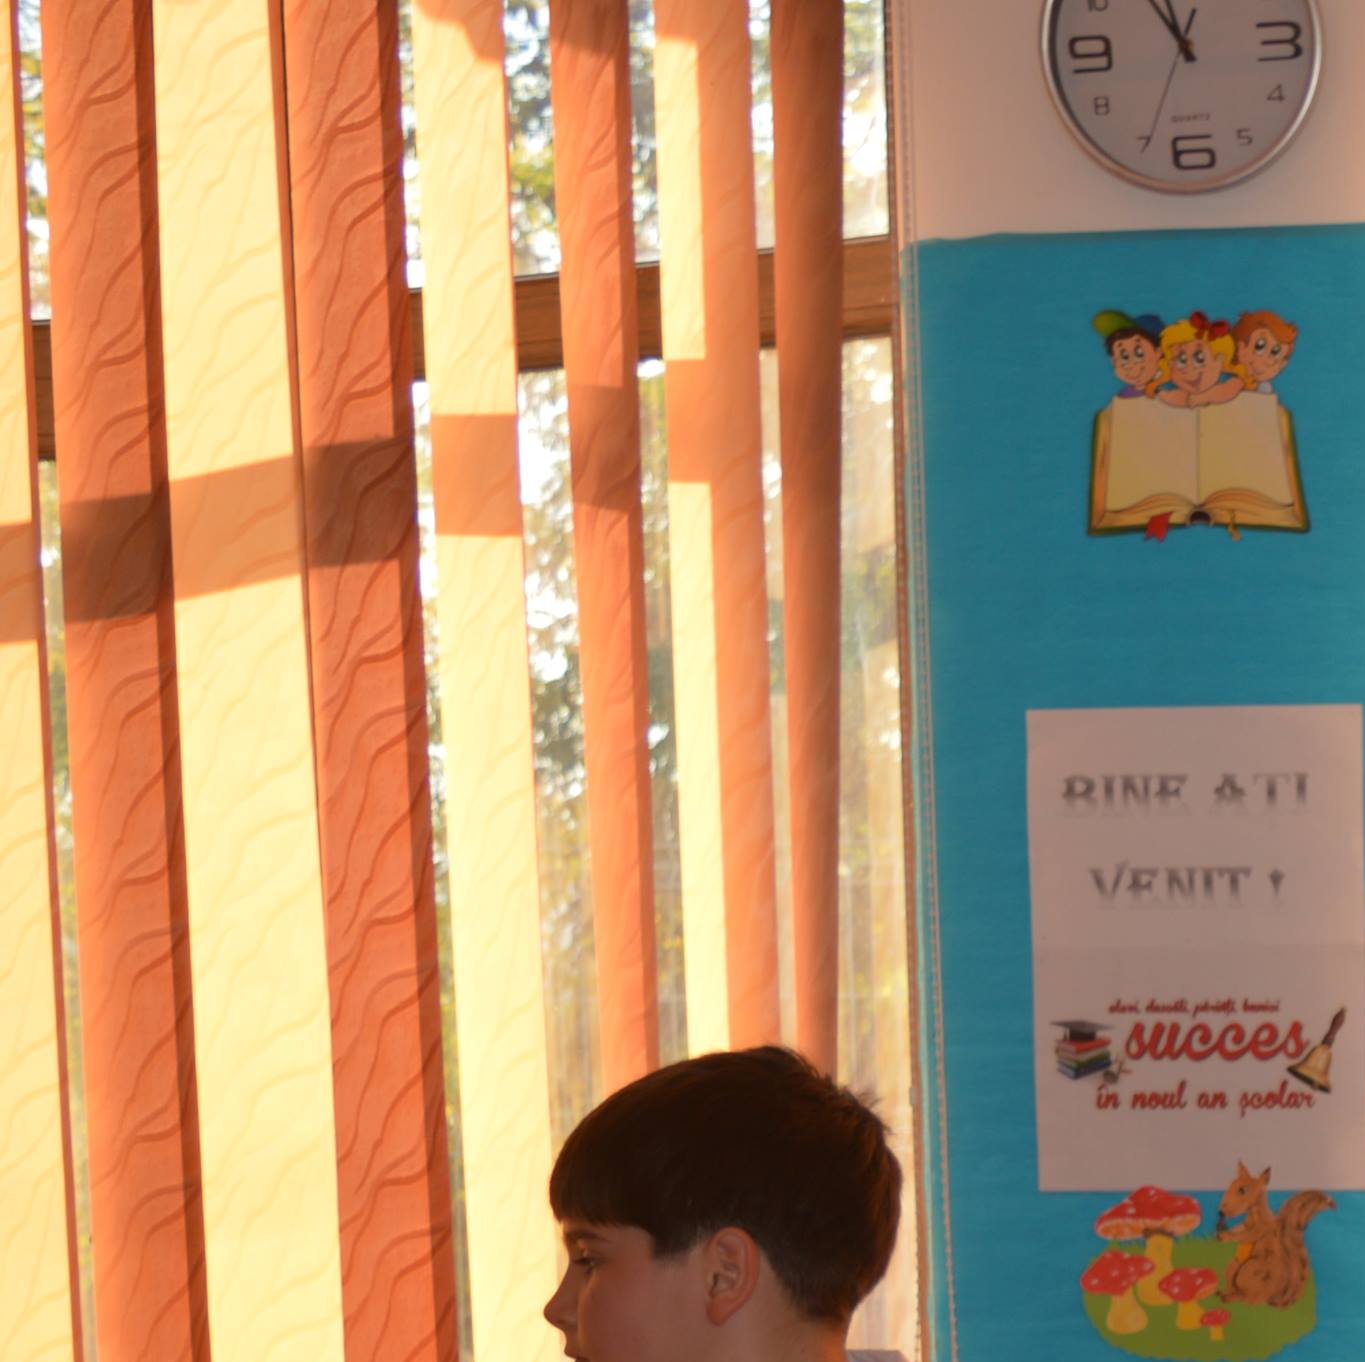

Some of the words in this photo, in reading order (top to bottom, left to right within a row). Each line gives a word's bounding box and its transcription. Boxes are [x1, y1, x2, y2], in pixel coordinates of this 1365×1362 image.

[1068, 34, 1112, 74] 9
[1256, 20, 1303, 62] 3
[1093, 96, 1110, 116] 8
[1265, 84, 1285, 103] 4
[1136, 136, 1151, 154] 7
[1171, 133, 1217, 171] 6
[1236, 128, 1254, 147] 5
[1124, 1021, 1309, 1062] succes
[1131, 1079, 1188, 1110] noul
[1196, 1090, 1229, 1110] an
